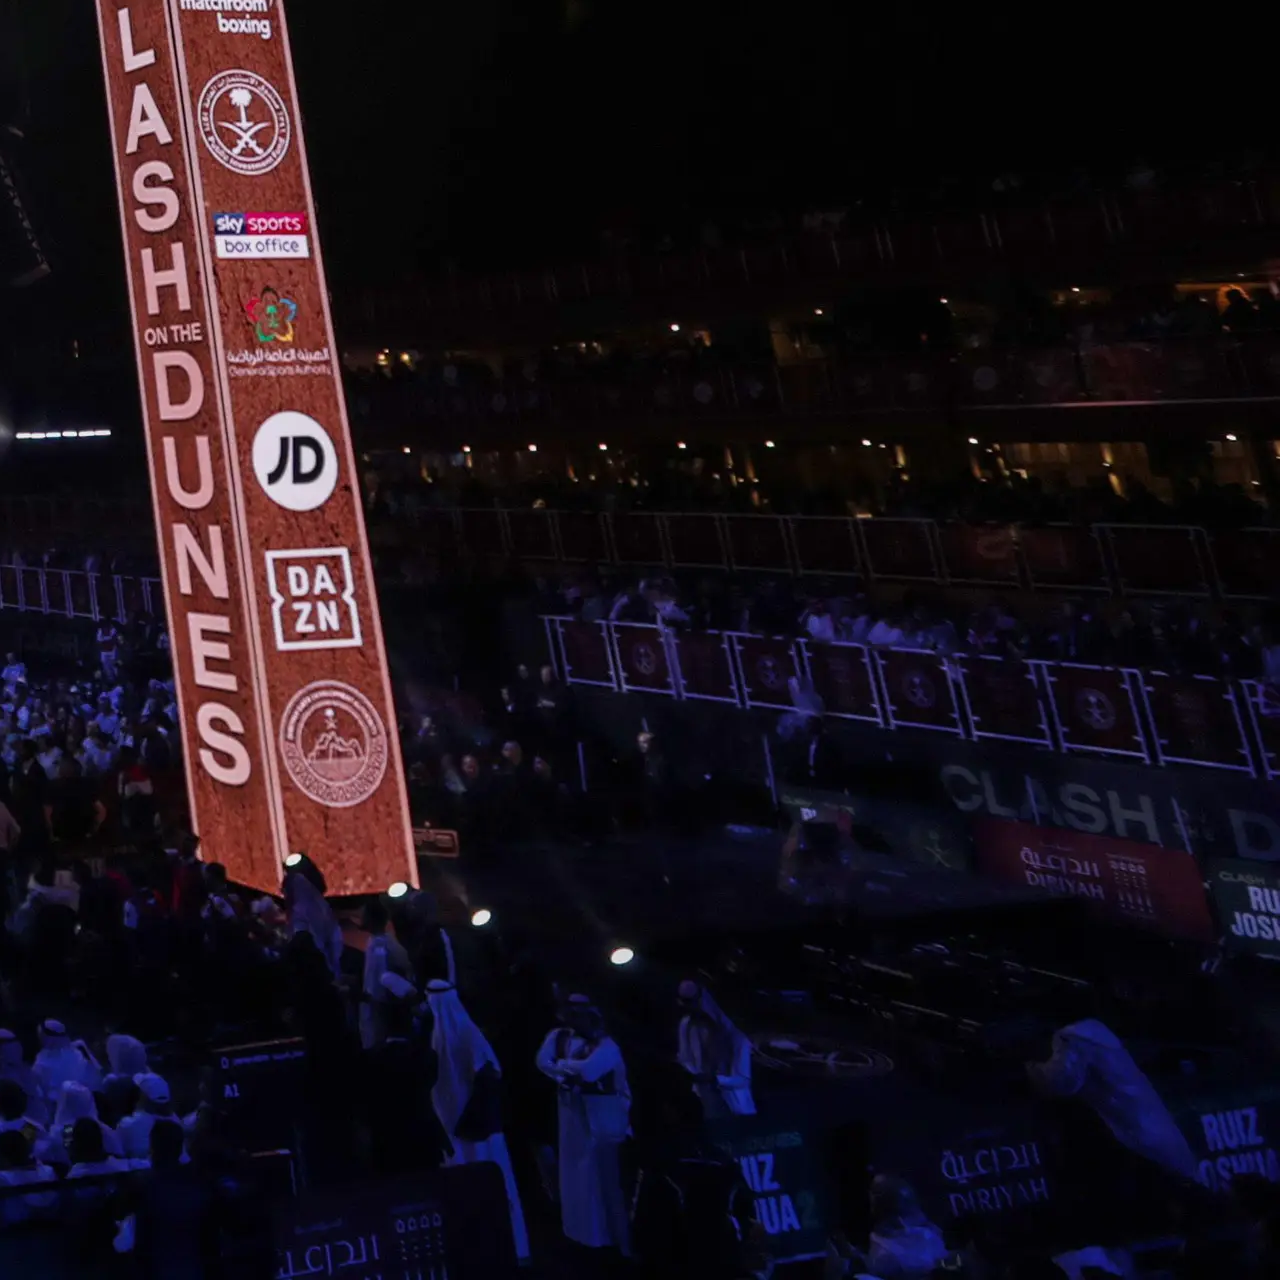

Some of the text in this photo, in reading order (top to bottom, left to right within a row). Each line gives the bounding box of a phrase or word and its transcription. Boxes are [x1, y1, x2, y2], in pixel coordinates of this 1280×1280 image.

[217, 13, 271, 40] boxing
[216, 214, 302, 233] sky sports
[225, 238, 300, 253] box office
[144, 322, 203, 346] ON THE
[268, 435, 325, 485] JD
[152, 351, 251, 786] DUNES
[1025, 870, 1105, 901] DIRIYAH
[1247, 885, 1280, 915] RU
[1231, 911, 1280, 941] JOS
[1200, 1106, 1265, 1152] RUIZ
